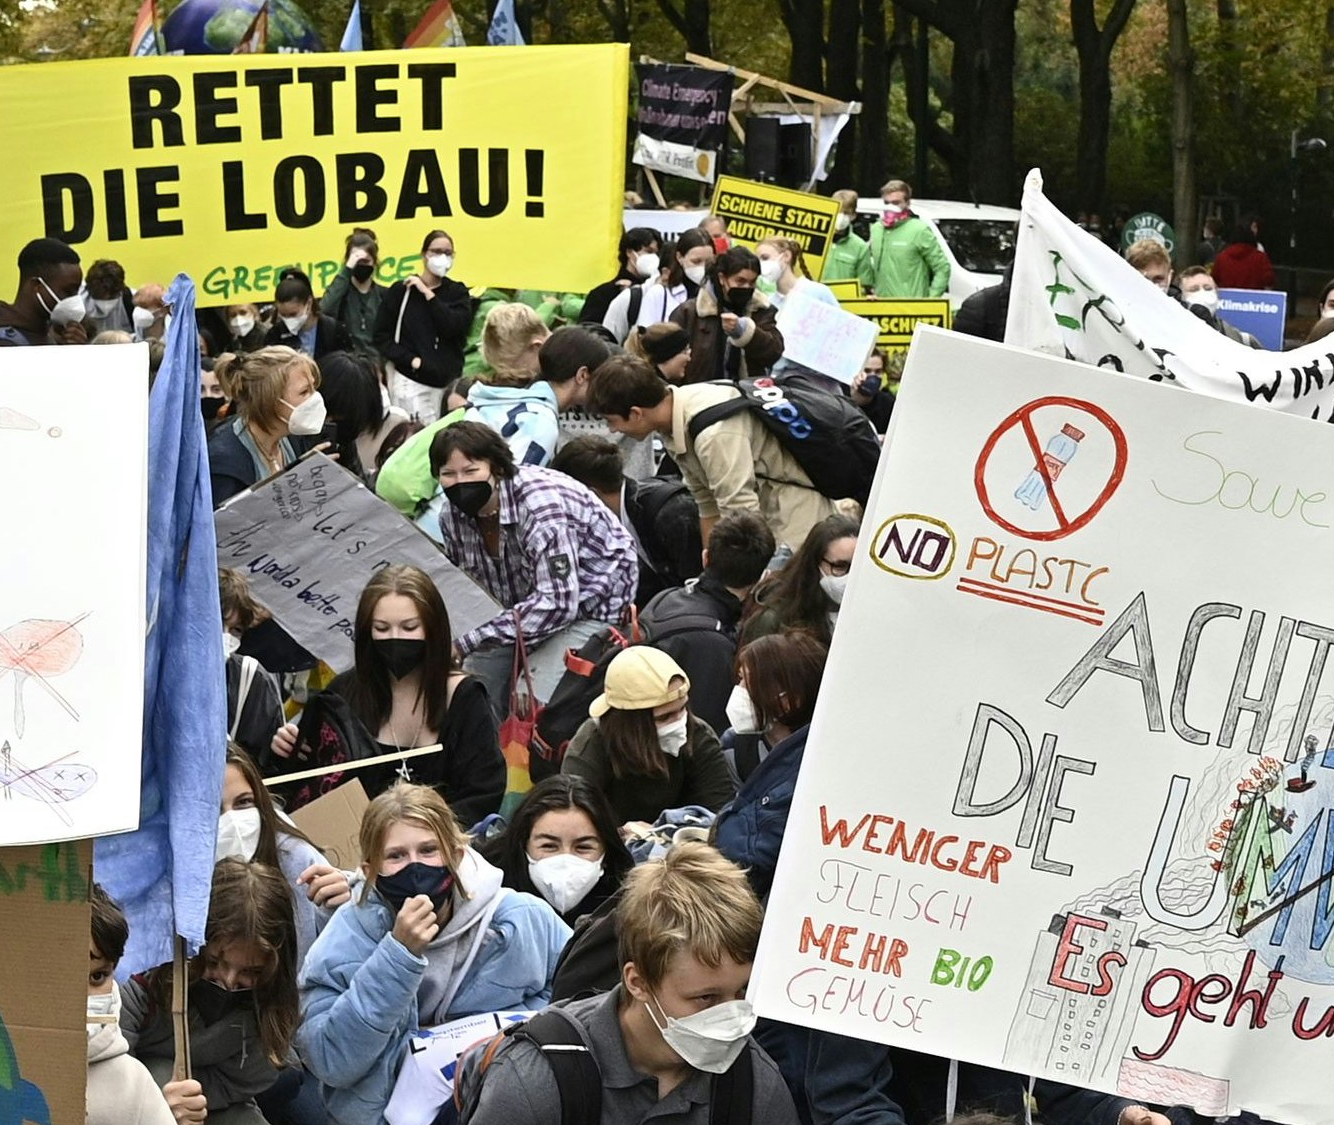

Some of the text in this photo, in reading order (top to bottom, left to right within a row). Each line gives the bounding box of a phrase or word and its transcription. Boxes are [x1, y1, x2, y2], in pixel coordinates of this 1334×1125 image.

[128, 63, 456, 149] RETTET
[41, 148, 546, 245] DIE LOBAU!
[719, 193, 831, 232] SCHIENE STATT
[203, 256, 423, 300] GREEPCE
[1216, 298, 1279, 315] Klimakrise
[296, 579, 342, 615] better
[878, 522, 1110, 607] NO PLASTC
[951, 702, 1099, 877] DIE
[817, 804, 1013, 887] WENIGER
[815, 858, 975, 932] FLEISCH
[797, 916, 995, 993] MEHR BIO
[1048, 911, 1128, 997] Es
[1132, 949, 1286, 1062] geht
